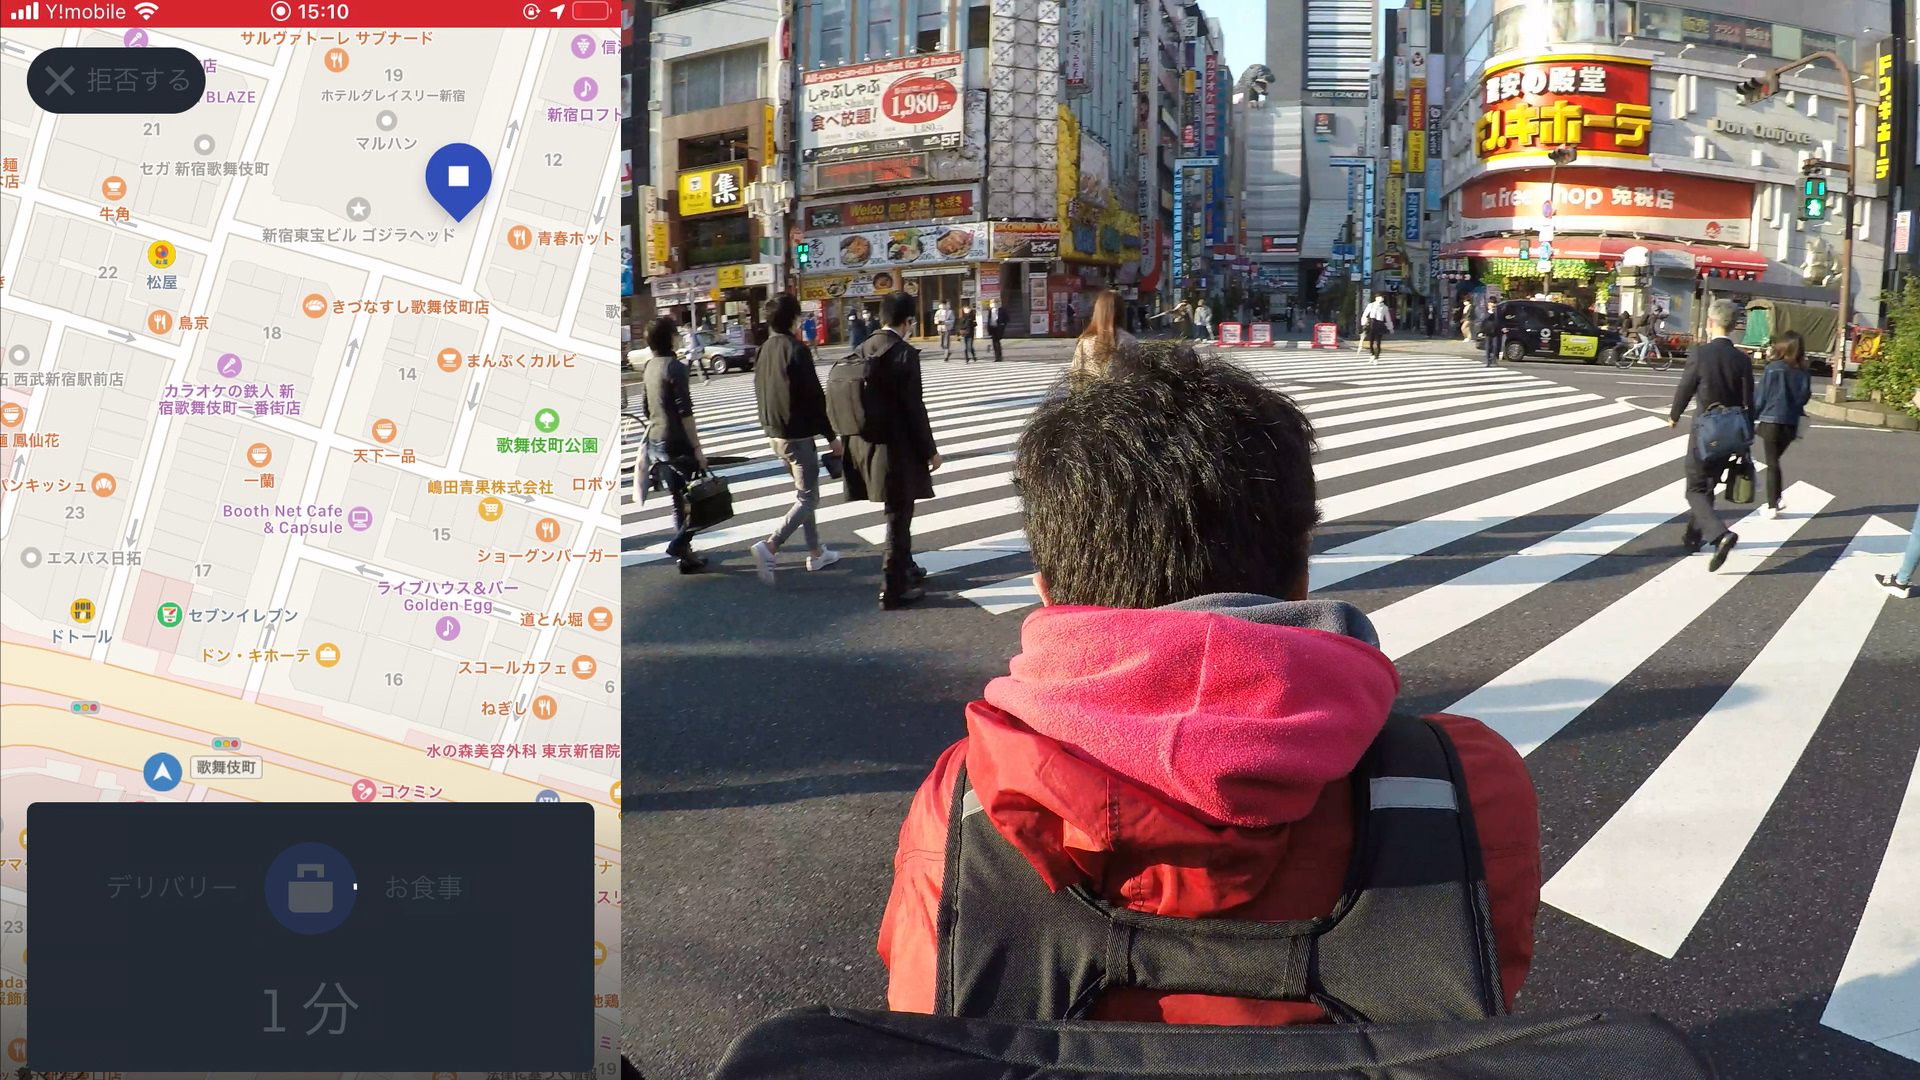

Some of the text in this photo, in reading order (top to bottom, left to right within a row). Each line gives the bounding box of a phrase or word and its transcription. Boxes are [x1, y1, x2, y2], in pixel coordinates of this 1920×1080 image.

[875, 61, 903, 73] buffet
[905, 60, 920, 69] for
[922, 58, 930, 67] 2
[931, 56, 960, 66] hours
[808, 79, 881, 103] しゃぶしゃぶ
[891, 91, 939, 119] 1,980
[941, 133, 960, 146] 5F
[1713, 119, 1811, 144] Don Quijote
[712, 172, 739, 204] 集
[1406, 193, 1420, 239] カラオケ
